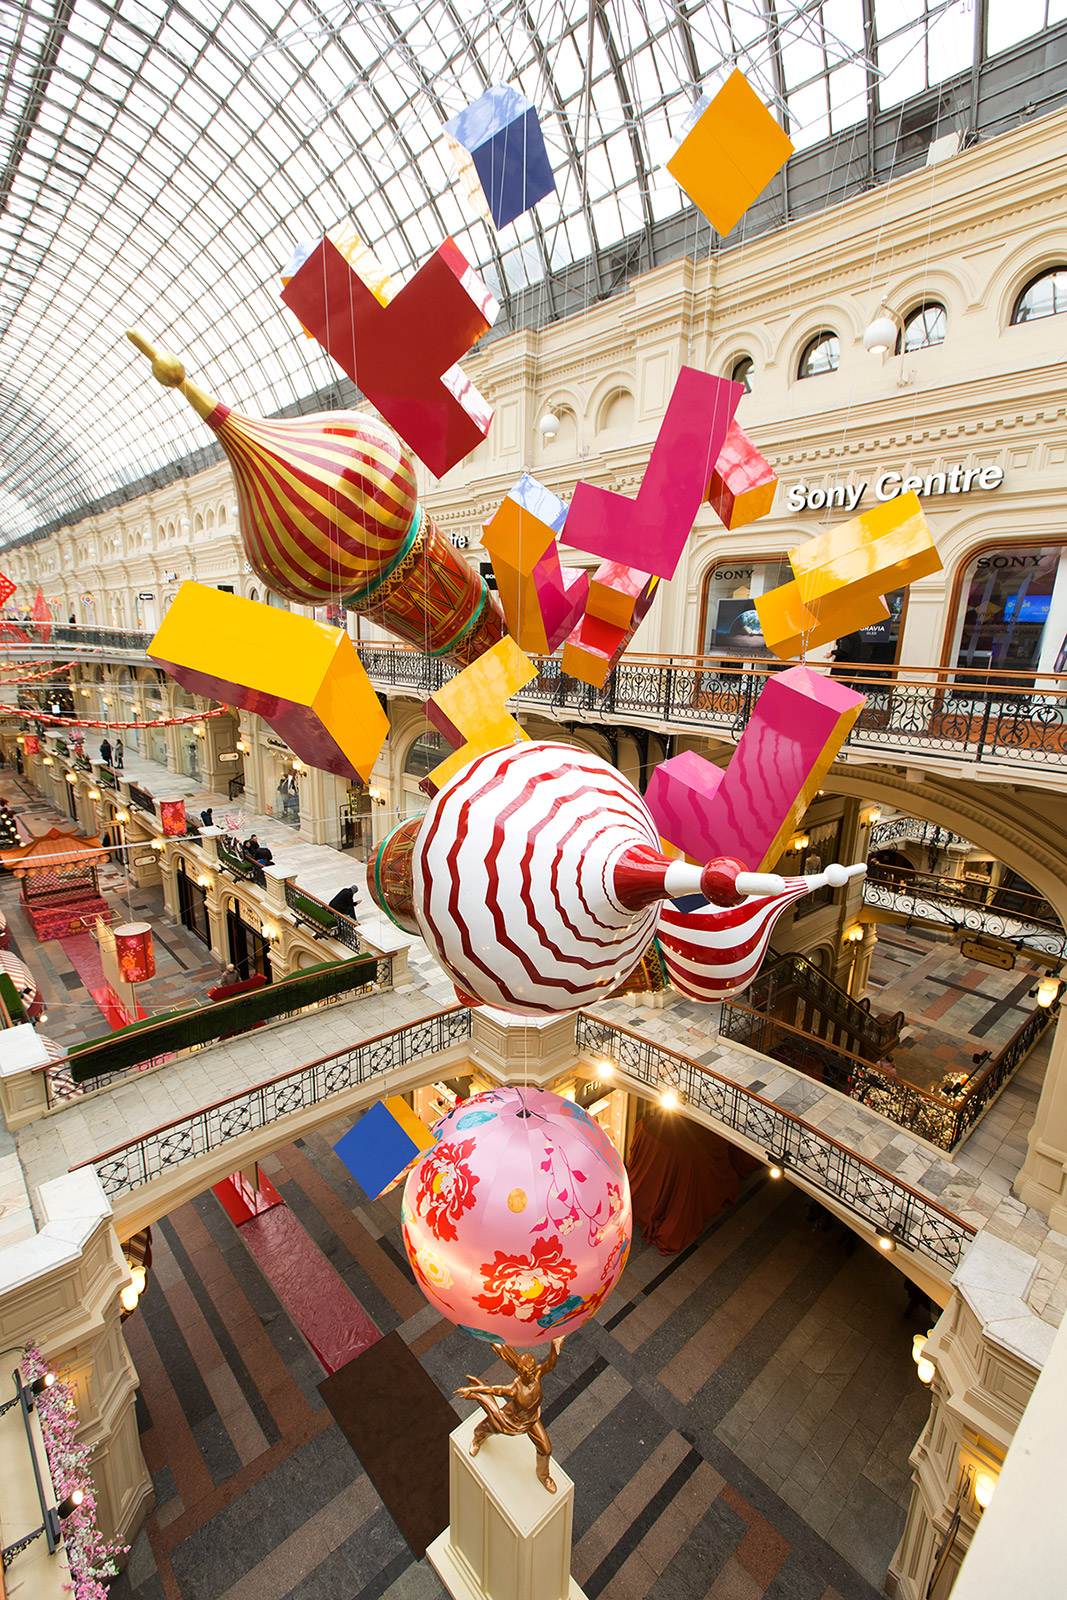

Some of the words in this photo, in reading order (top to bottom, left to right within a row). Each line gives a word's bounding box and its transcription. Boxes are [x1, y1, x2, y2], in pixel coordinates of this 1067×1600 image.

[787, 484, 868, 512] Sony
[875, 464, 1004, 502] Centre
[977, 555, 1044, 569] SONY
[714, 570, 754, 580] SONY
